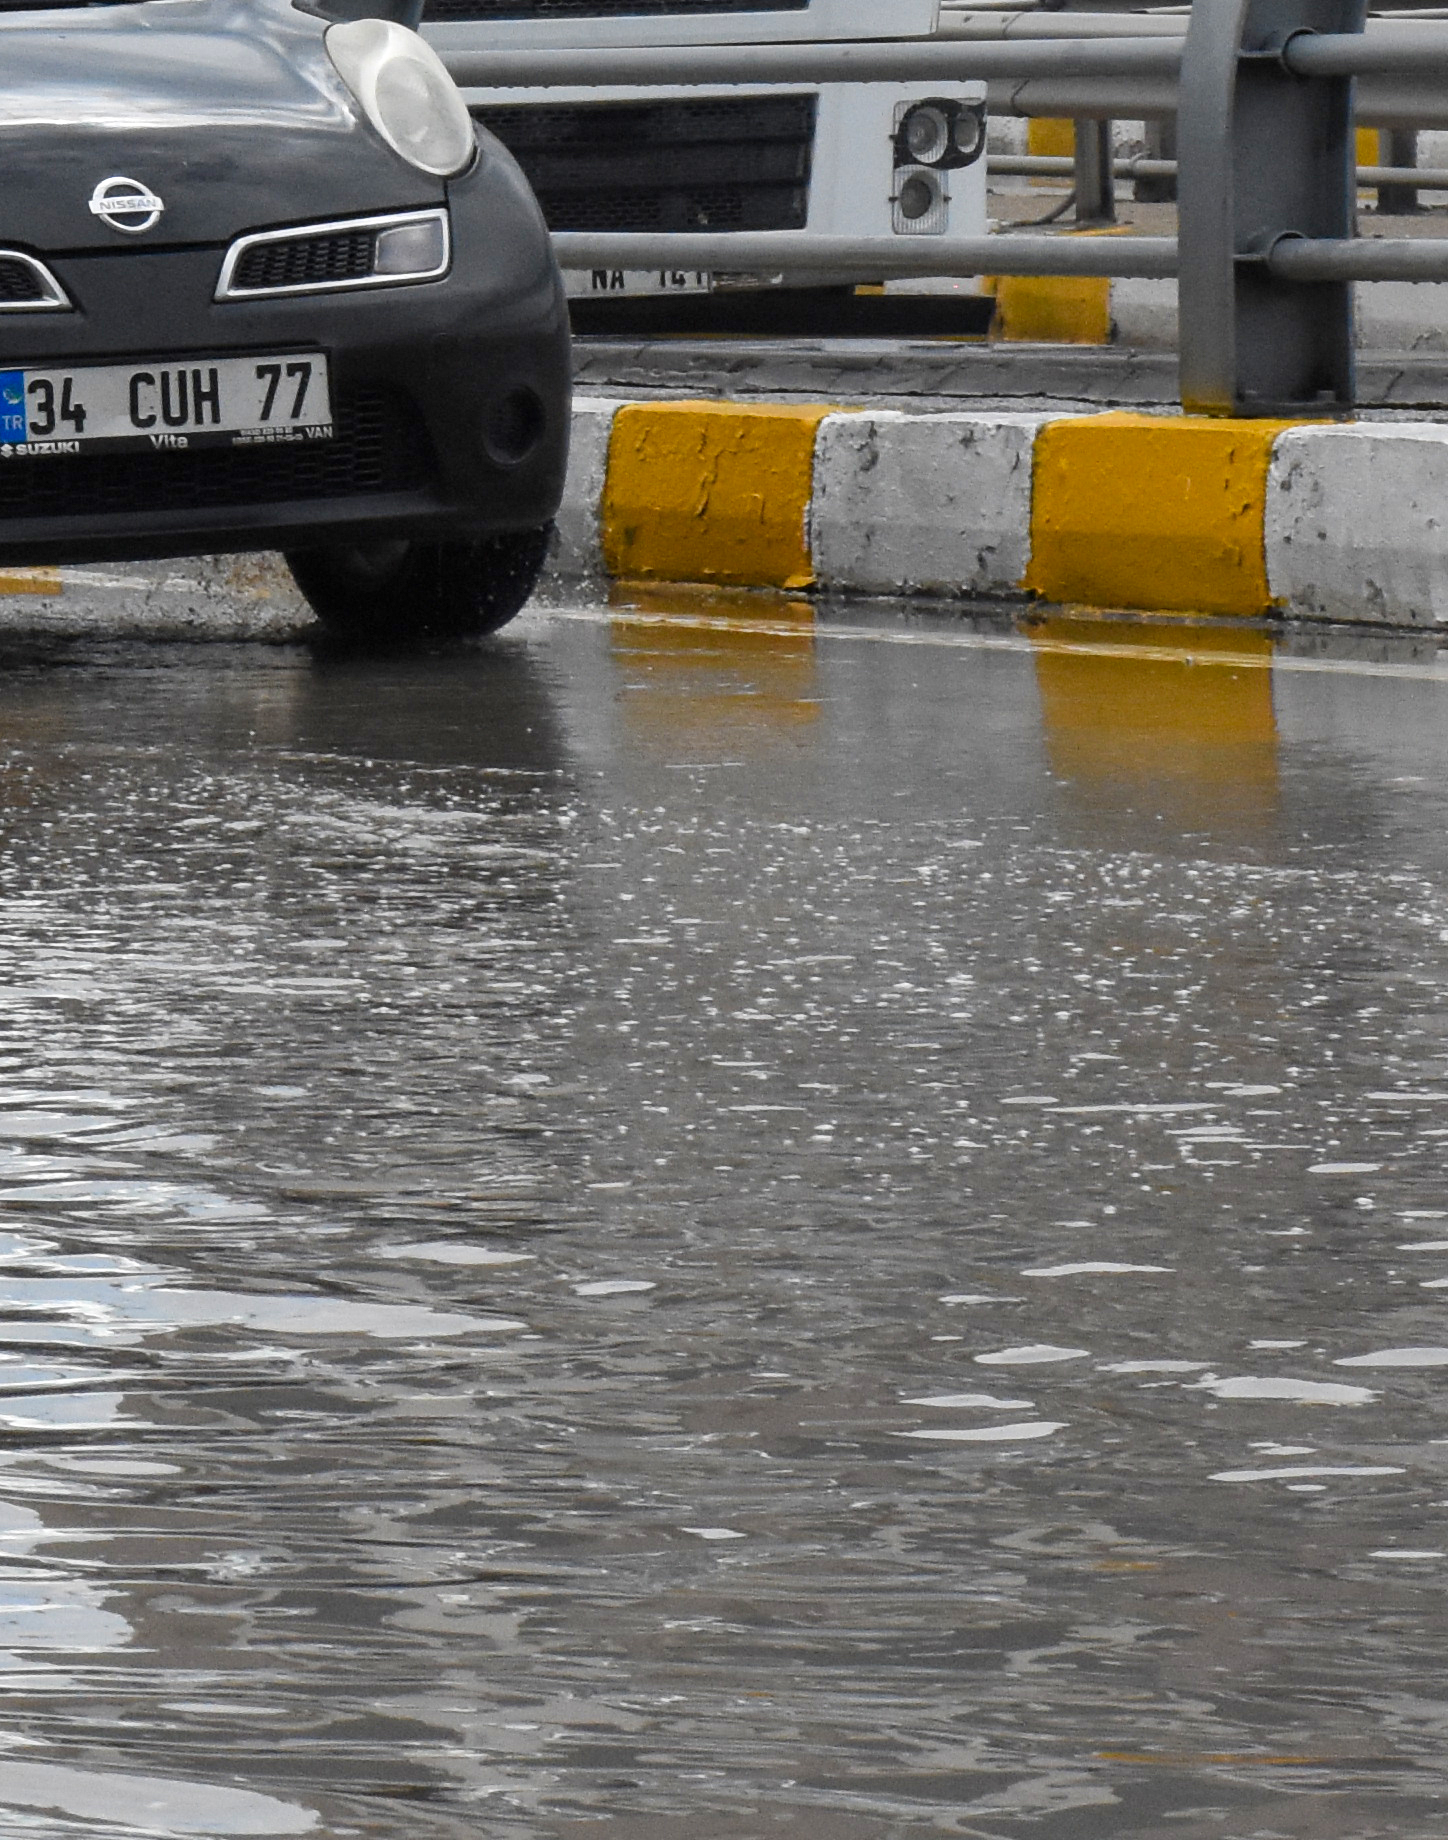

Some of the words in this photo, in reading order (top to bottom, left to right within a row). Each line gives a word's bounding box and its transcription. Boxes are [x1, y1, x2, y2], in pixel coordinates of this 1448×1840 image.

[99, 199, 157, 210] NISSAN
[27, 377, 87, 436] 34
[129, 367, 222, 429] CUH
[256, 361, 313, 422] 77
[2, 414, 23, 430] TR
[305, 425, 334, 439] VAN
[15, 441, 80, 456] SUZUKI
